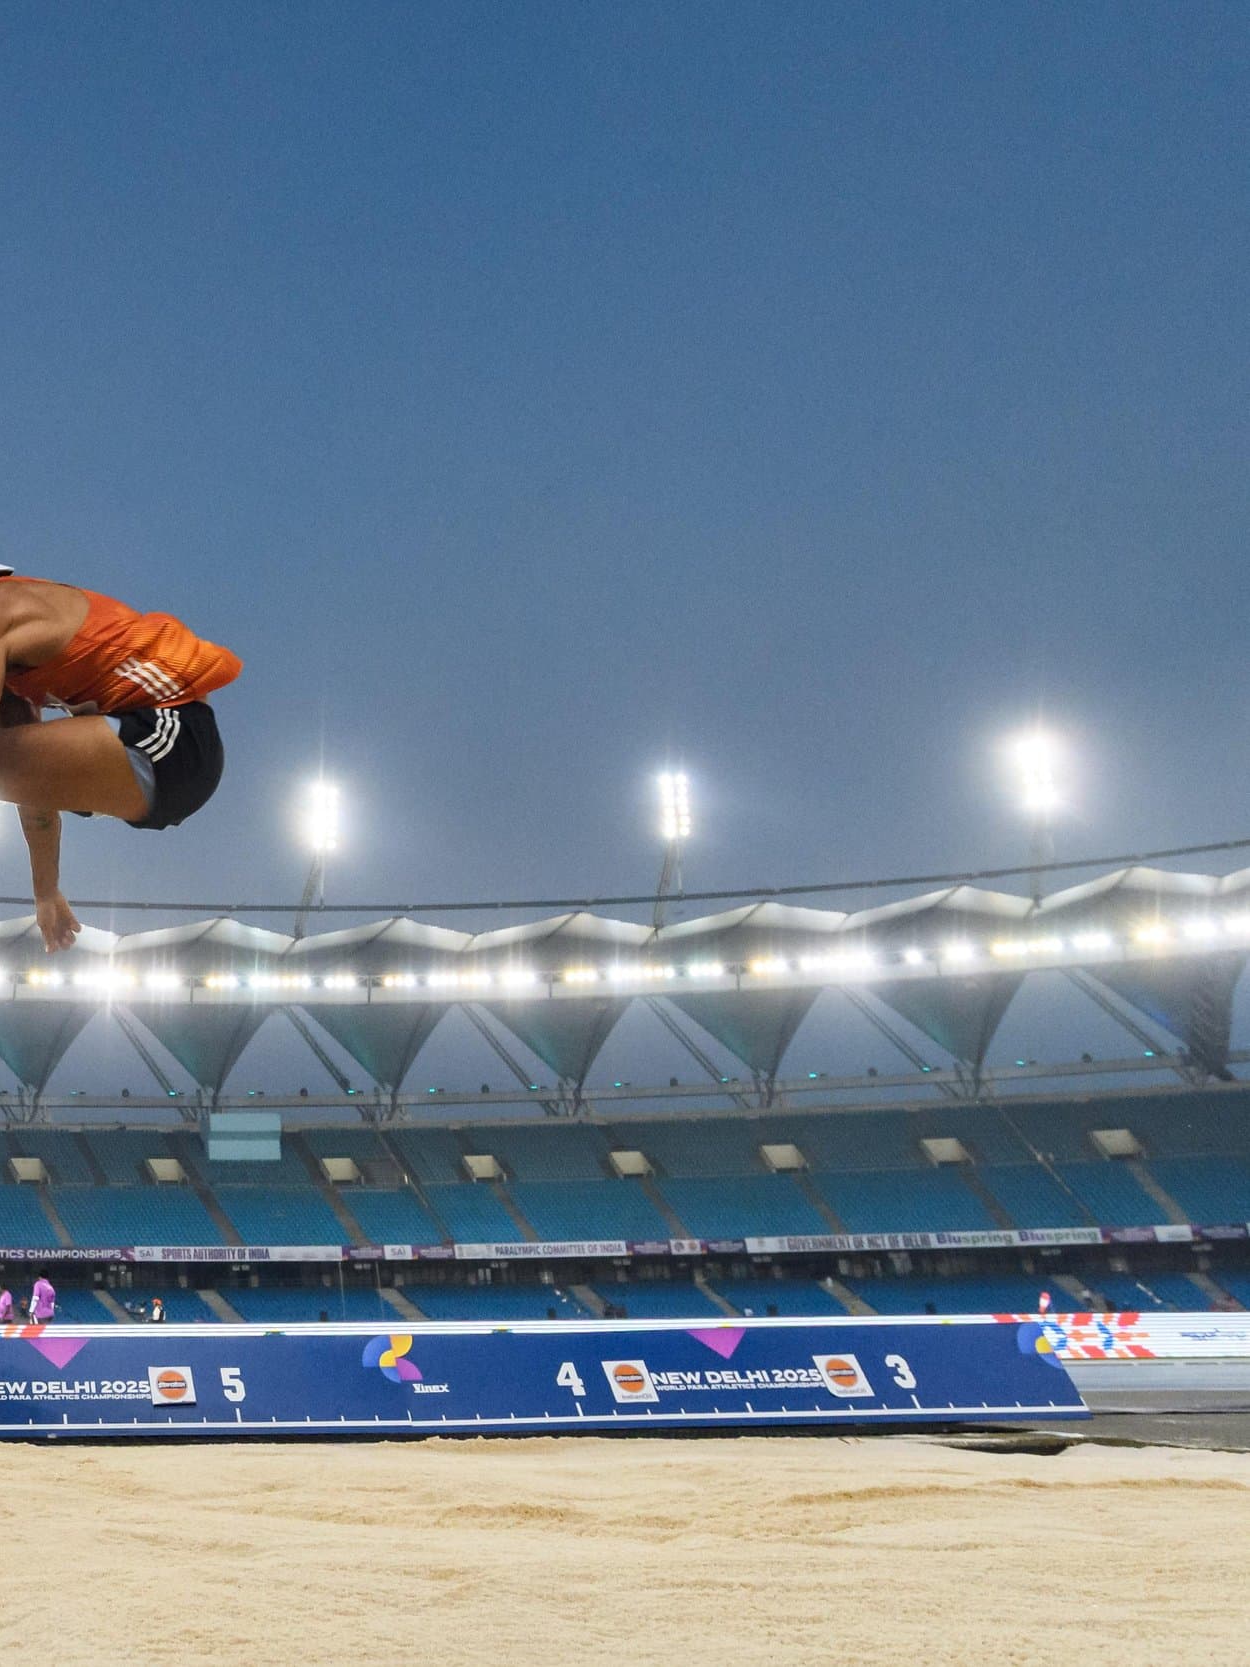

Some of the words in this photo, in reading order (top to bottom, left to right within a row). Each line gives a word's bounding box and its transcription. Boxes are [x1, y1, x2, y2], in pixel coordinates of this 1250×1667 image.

[936, 1231, 1014, 1246] Bluspring
[1018, 1229, 1098, 1243] Bluspring
[27, 1249, 122, 1260] CHAMPIONSHIPS
[162, 1248, 191, 1260] SPORTS
[193, 1248, 236, 1260] AUTHORITY
[238, 1248, 249, 1259] OF
[251, 1248, 271, 1259] INDIA
[495, 1245, 541, 1257] PARALYMPIC
[542, 1243, 585, 1256] COMMITTEE
[600, 1242, 623, 1253] INDIA
[650, 1372, 701, 1385] NEW
[704, 1370, 770, 1384] DELHI
[772, 1369, 824, 1382] 2025
[885, 1354, 917, 1388] 3
[220, 1368, 246, 1402] 5
[556, 1362, 586, 1396] 4
[31, 1381, 96, 1394] DELHI
[100, 1381, 151, 1394] 2025
[413, 1383, 449, 1393] Vinex
[81, 1393, 151, 1401] CHAMPIONSHIPS
